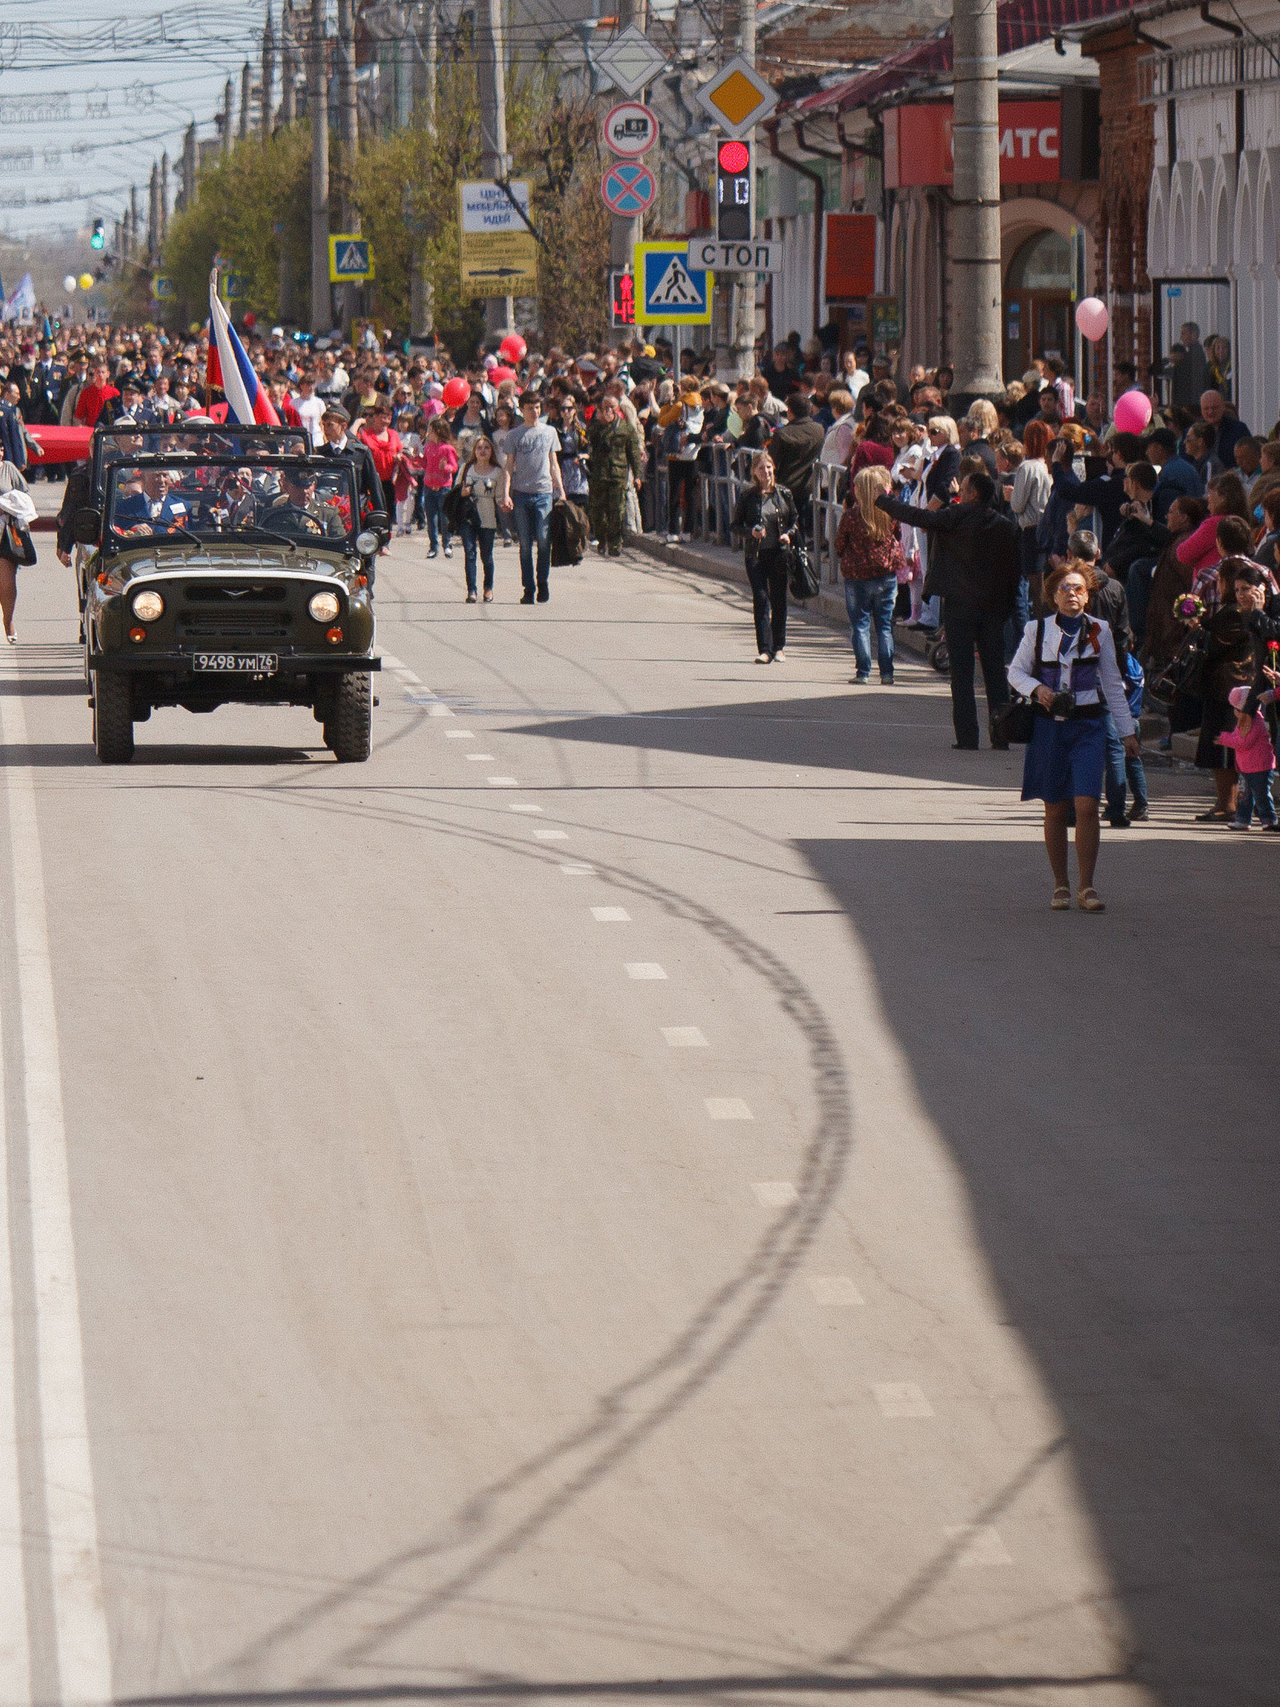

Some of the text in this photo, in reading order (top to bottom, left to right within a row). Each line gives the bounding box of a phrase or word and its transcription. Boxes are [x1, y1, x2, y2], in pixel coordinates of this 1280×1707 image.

[701, 244, 770, 268] СТОП
[199, 655, 236, 669] 9498
[259, 655, 273, 666] 76
